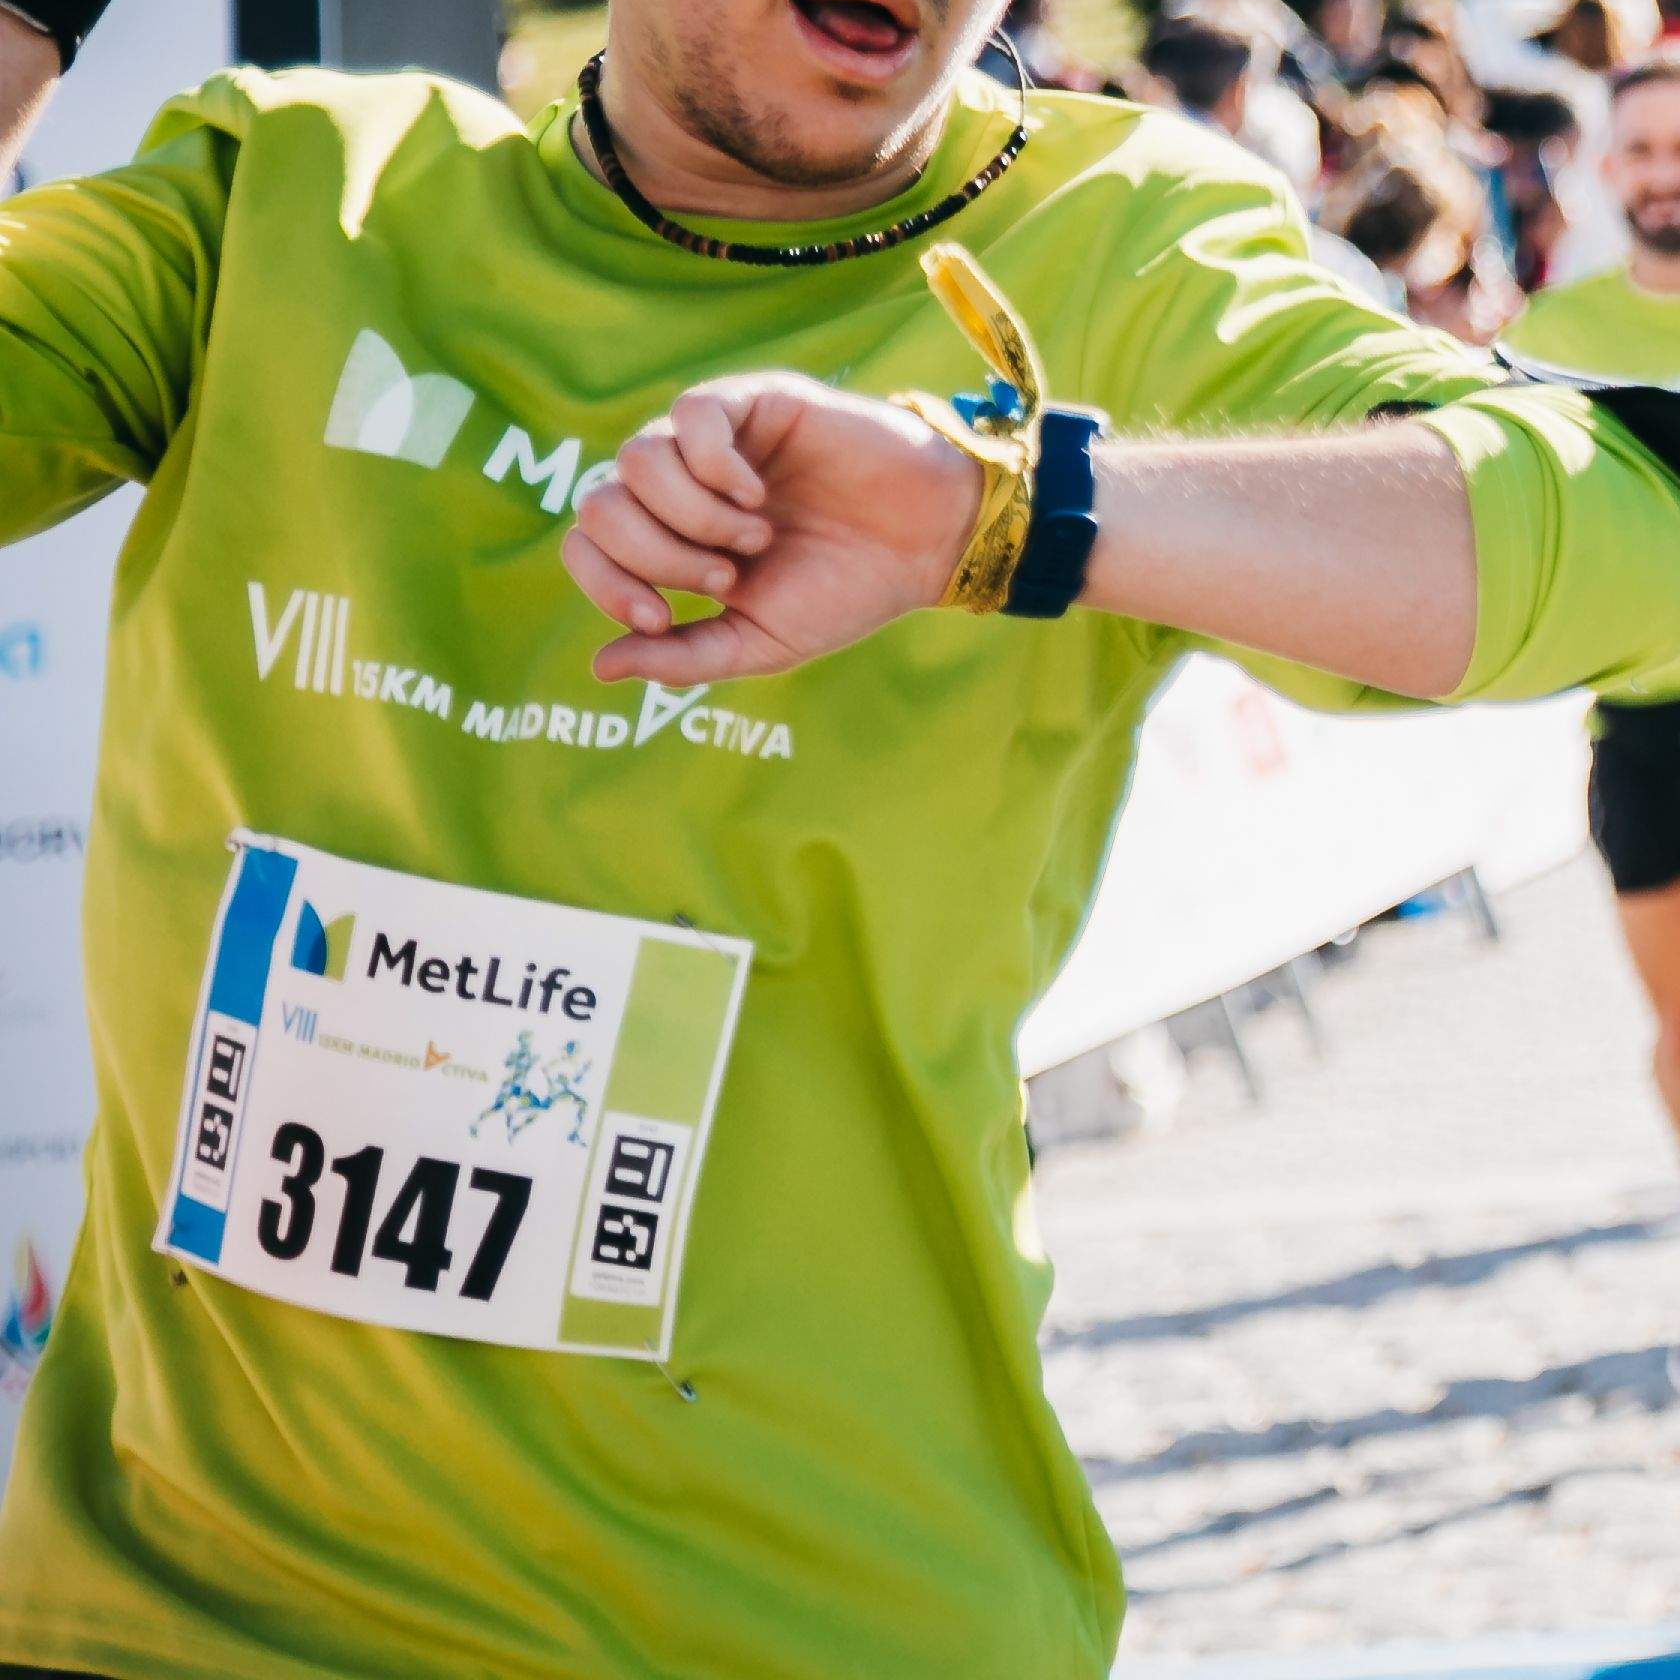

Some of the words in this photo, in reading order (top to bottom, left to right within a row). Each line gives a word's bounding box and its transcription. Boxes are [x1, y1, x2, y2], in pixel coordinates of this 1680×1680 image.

[247, 581, 350, 696] VIII
[352, 659, 455, 721] 15KM
[461, 701, 629, 749] MADRID
[282, 1001, 318, 1044] VIII
[367, 932, 597, 1022] MetLife
[257, 1121, 534, 1303] 3147
